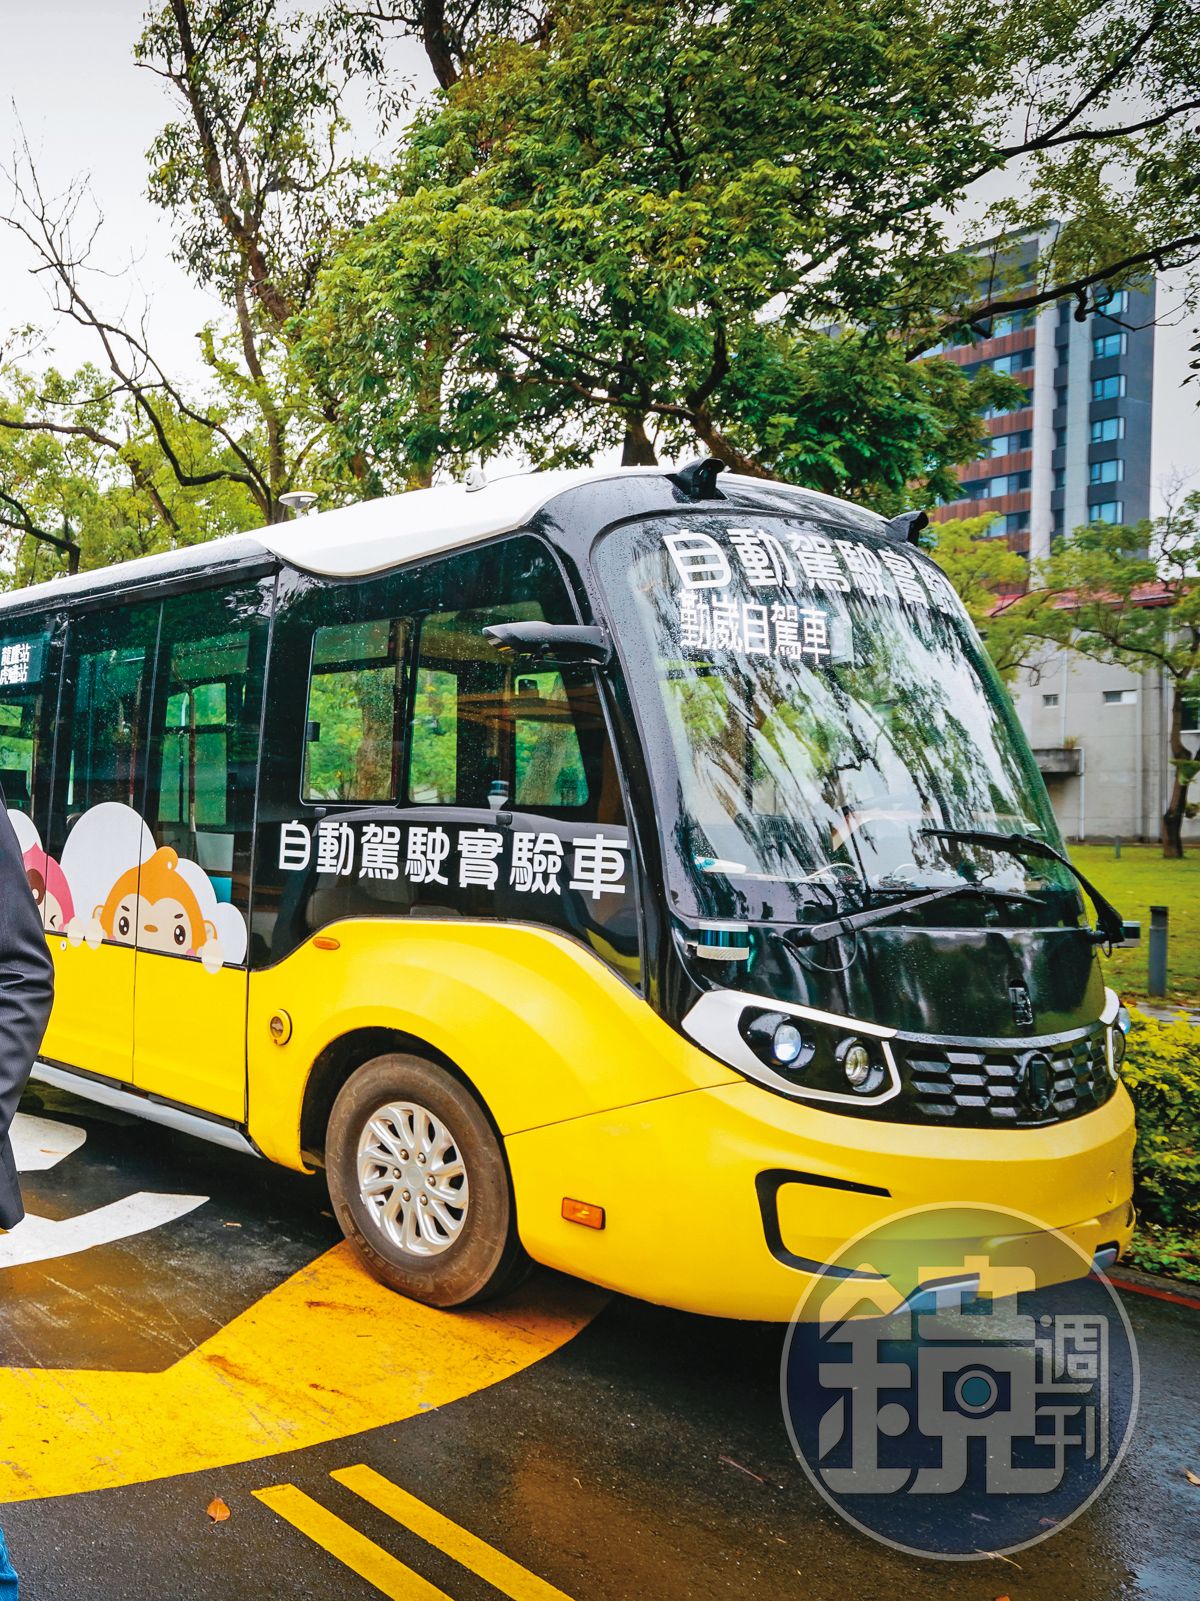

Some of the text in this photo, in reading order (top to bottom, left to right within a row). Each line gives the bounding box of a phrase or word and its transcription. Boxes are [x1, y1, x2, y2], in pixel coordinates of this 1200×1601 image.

[277, 820, 629, 900] 自動駕駛實驗車
